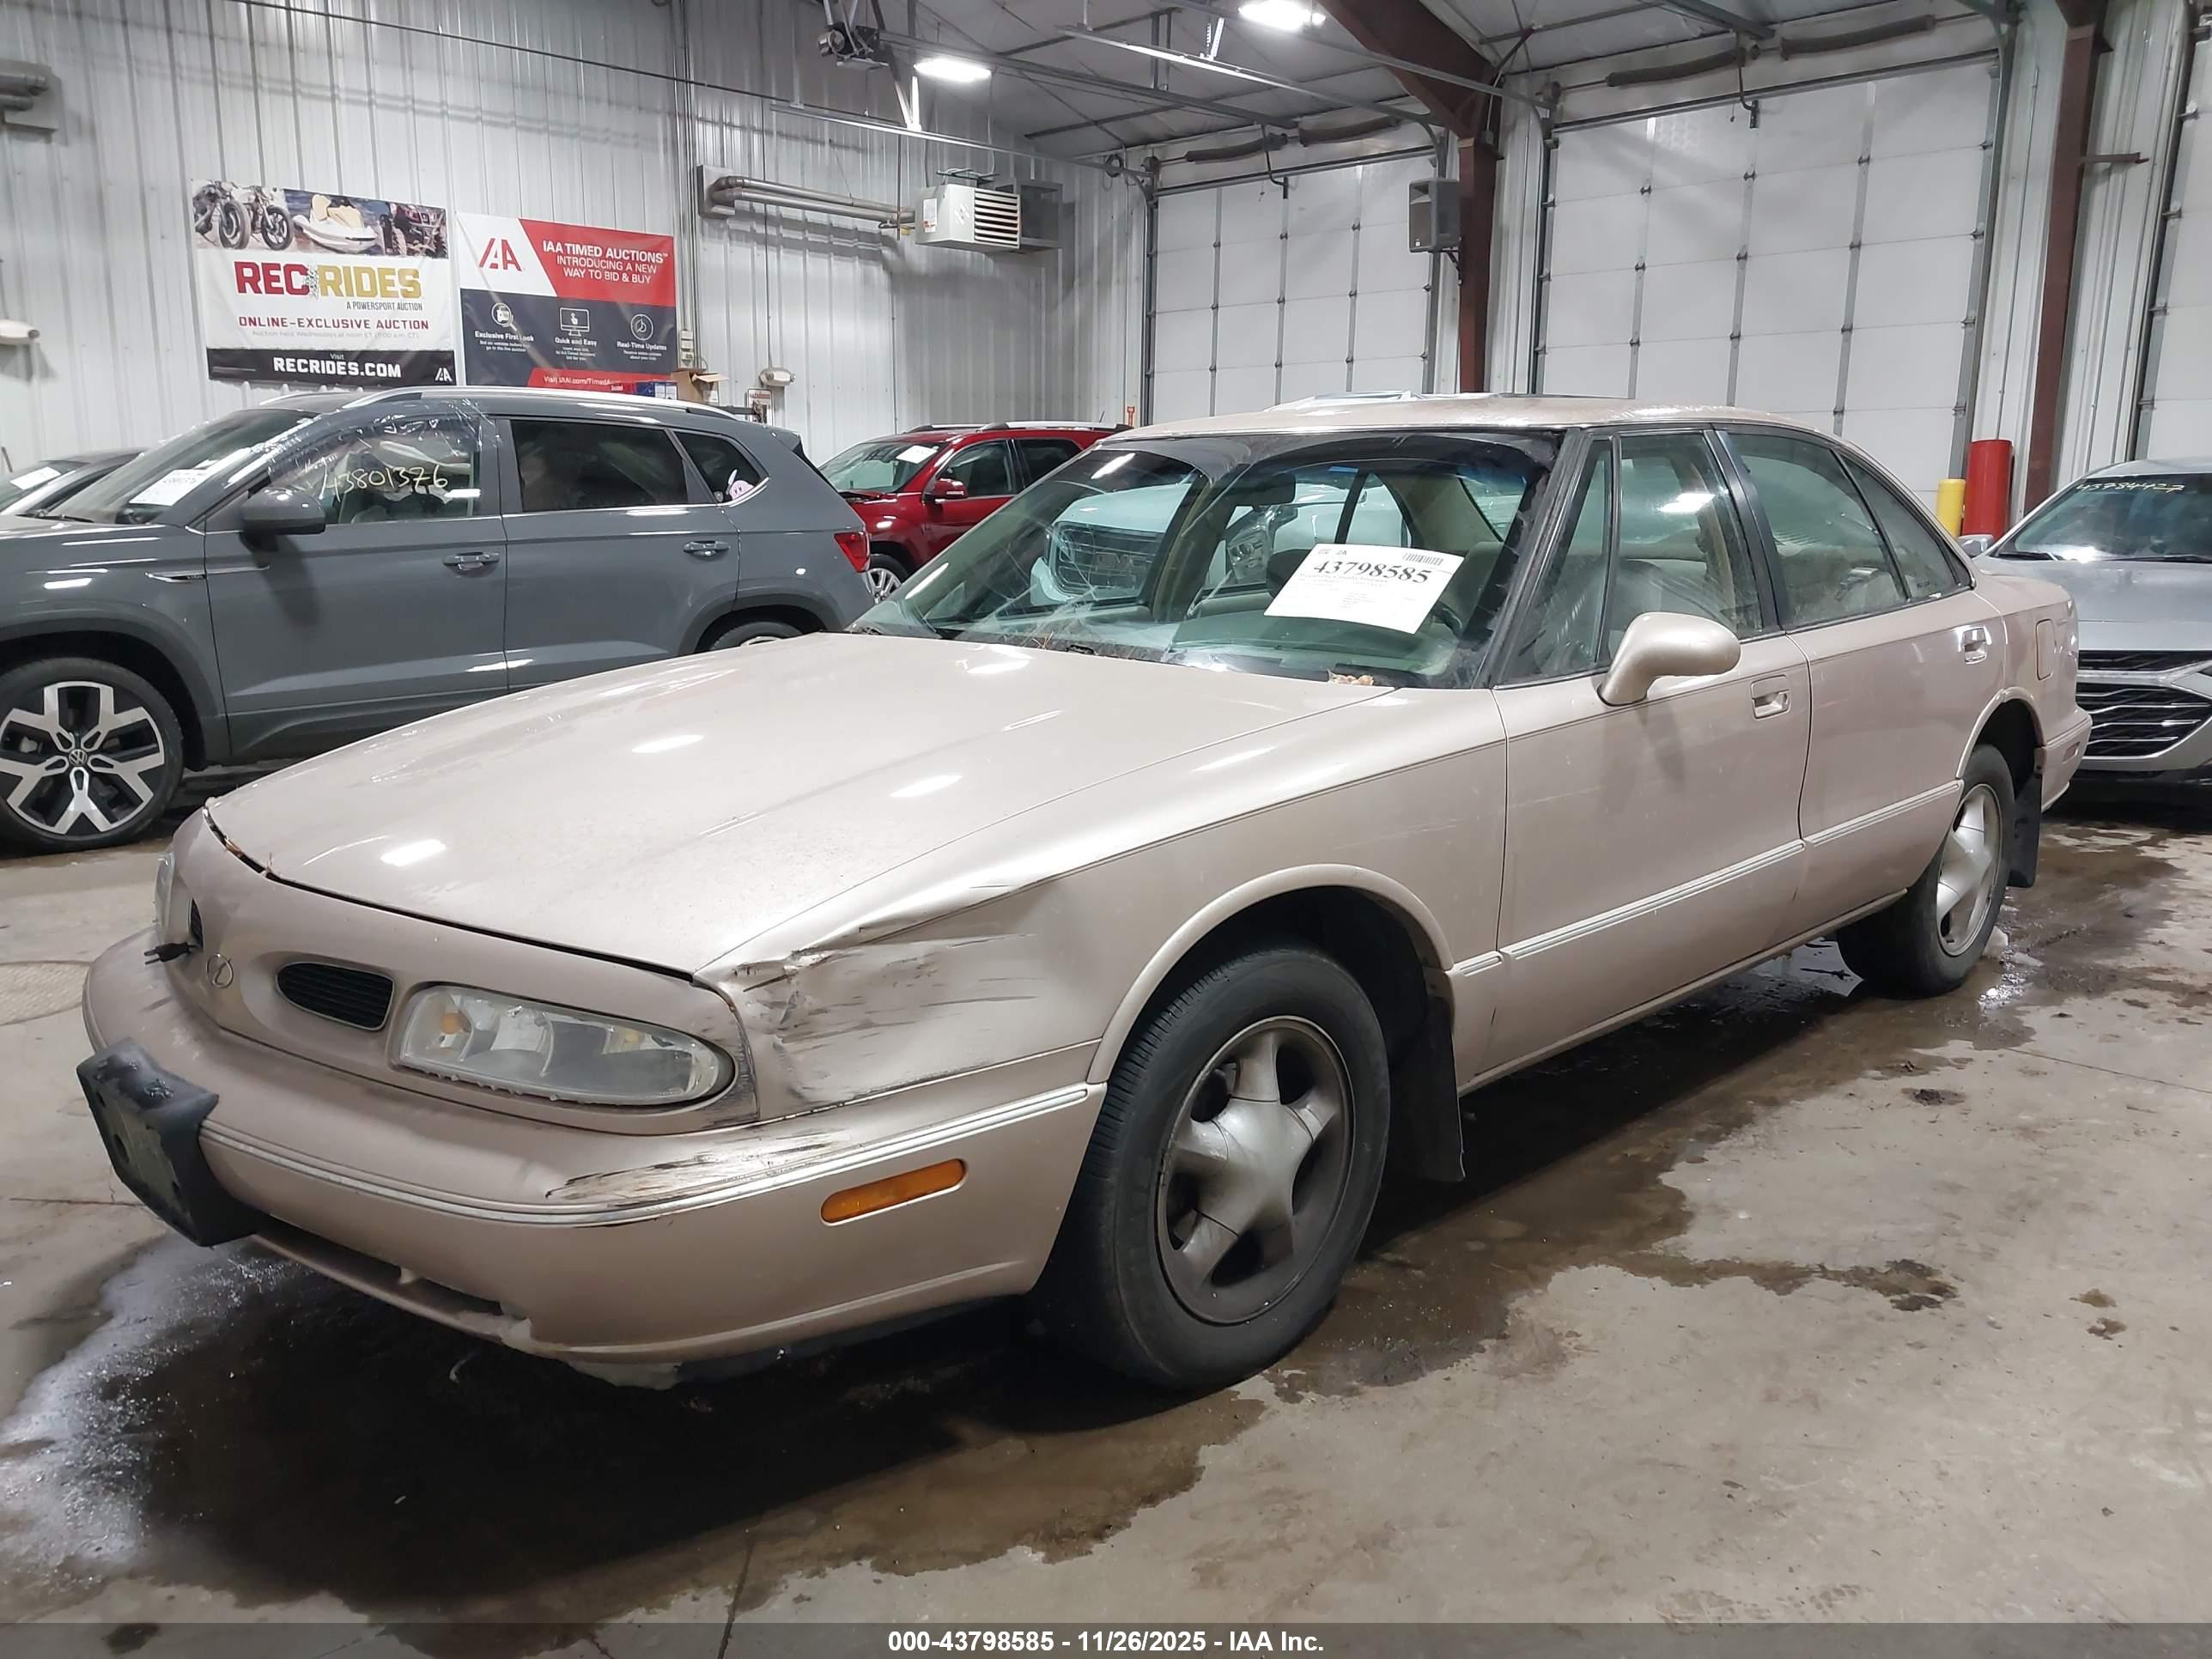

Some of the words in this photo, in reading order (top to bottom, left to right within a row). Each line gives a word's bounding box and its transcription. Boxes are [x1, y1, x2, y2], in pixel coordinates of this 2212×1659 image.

[543, 240, 563, 253] IAA
[565, 243, 603, 258] TIMED
[556, 255, 623, 271] INTRODUCING
[635, 264, 657, 274] NEW
[234, 260, 311, 296] REC
[317, 265, 422, 299] RIDES
[563, 267, 586, 278] WAY
[588, 270, 602, 280] TO
[605, 271, 619, 282] BID
[622, 273, 629, 283] &
[632, 274, 652, 284] BUY
[346, 301, 351, 310] A
[353, 301, 395, 311] POWERSPORT
[397, 302, 423, 312] AUCTION
[239, 316, 371, 329] ONLINE-EXCLUSIVE
[376, 319, 429, 330] AUCTION
[475, 331, 504, 339] Exclusive
[583, 338, 598, 347] Easy
[273, 357, 402, 379] RECRIDES.COM
[1314, 560, 1432, 584] 43798585
